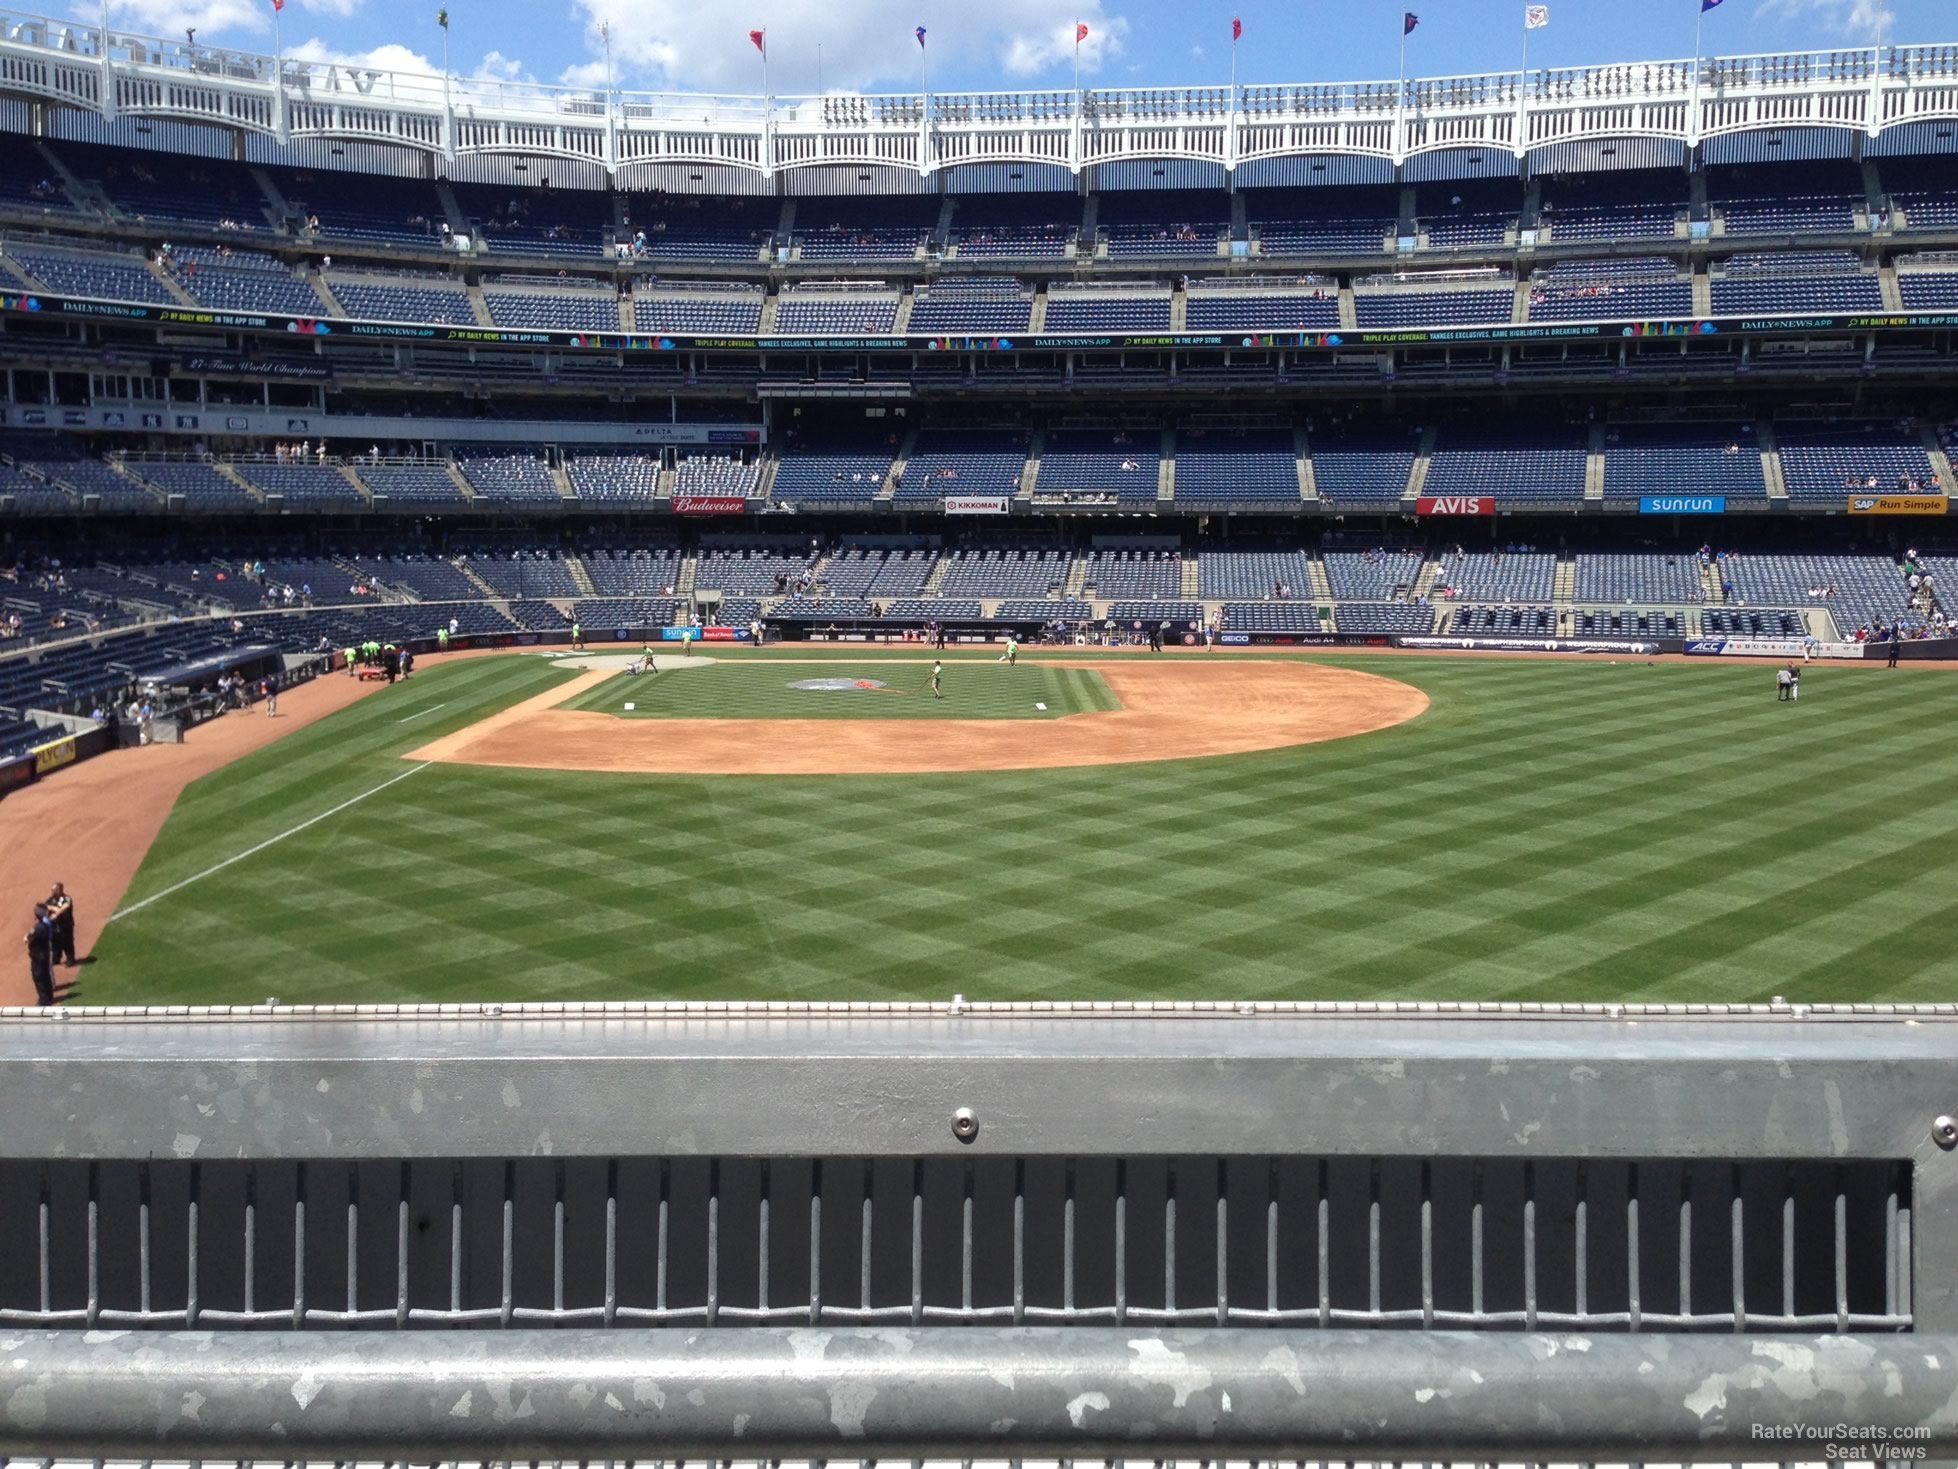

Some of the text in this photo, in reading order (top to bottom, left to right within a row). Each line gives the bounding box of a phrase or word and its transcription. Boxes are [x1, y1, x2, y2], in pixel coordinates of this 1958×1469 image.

[63, 302, 147, 317] DAILY NEWS APP
[222, 316, 233, 324] THE
[234, 317, 247, 325] APP
[1741, 321, 1774, 330] DAILY
[352, 325, 383, 335] DAILY
[387, 327, 417, 336] NEWS
[239, 361, 272, 372] World
[274, 364, 326, 376] Champions
[674, 498, 742, 511] Budweiser
[1432, 499, 1479, 513] AVIS
[1652, 499, 1712, 510] sunrun
[1854, 500, 1874, 509] SAP
[1904, 501, 1940, 509] Simple
